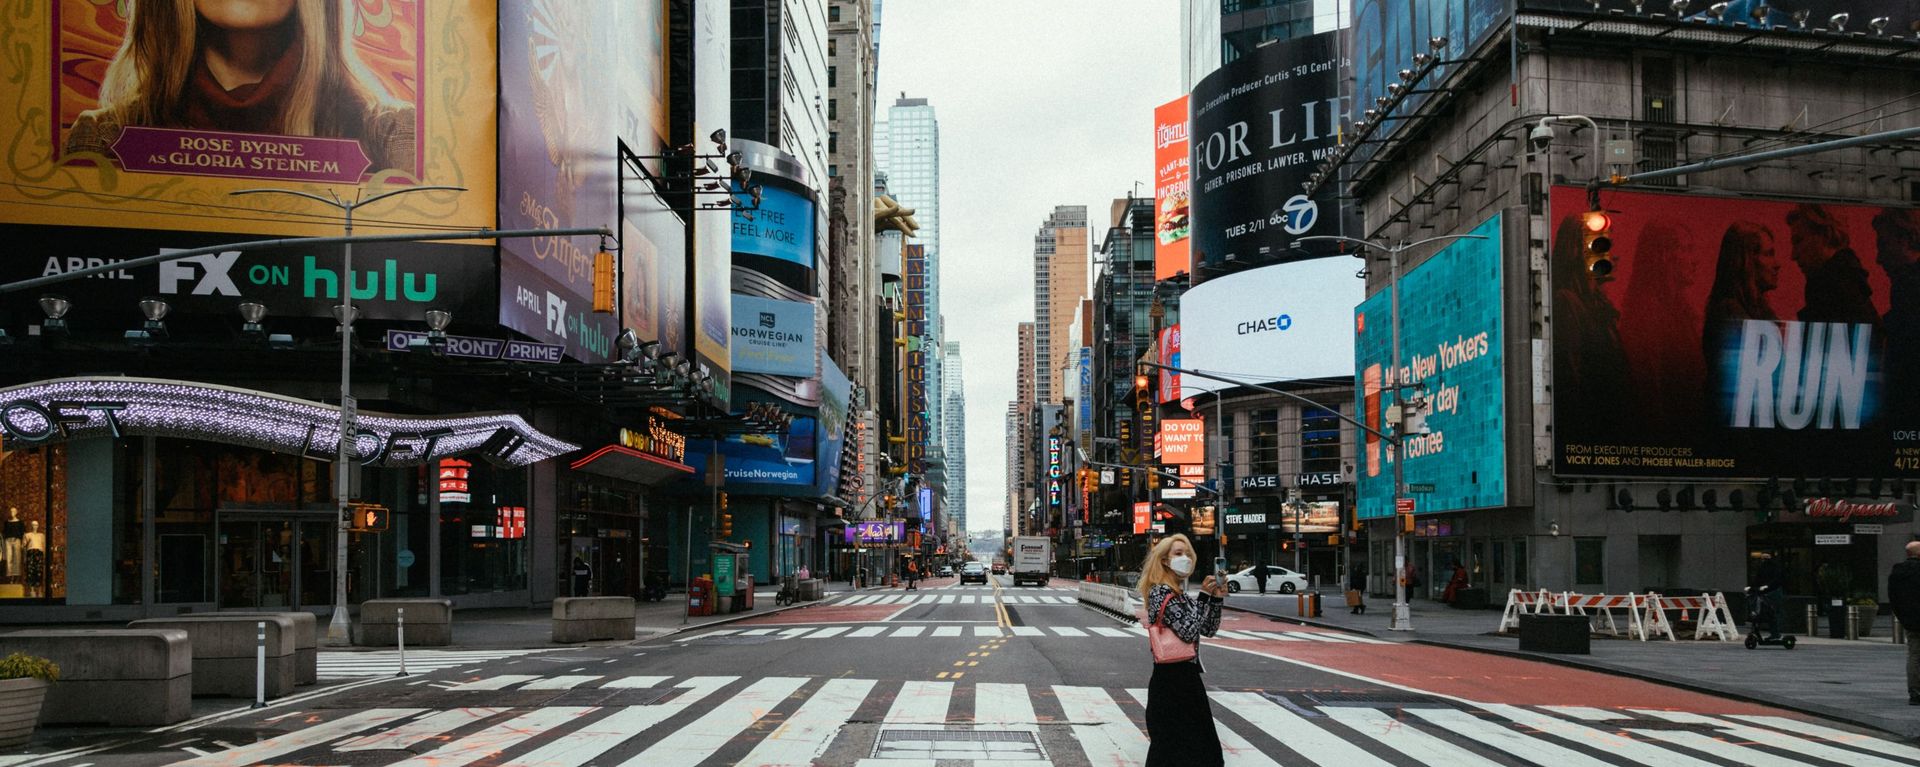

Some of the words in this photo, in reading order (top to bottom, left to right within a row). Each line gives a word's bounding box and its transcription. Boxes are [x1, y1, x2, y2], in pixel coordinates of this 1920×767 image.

[1205, 92, 1230, 111] Executive
[1231, 79, 1262, 98] Producer
[1264, 70, 1290, 85] Curtis
[179, 136, 234, 152] ROSE
[240, 140, 305, 157] BYRNE
[1195, 120, 1251, 182] FOR
[149, 154, 167, 164] AS
[169, 152, 245, 169] GLORIA
[250, 157, 341, 175] STEINEM
[1204, 175, 1225, 194] FATHER.
[1226, 162, 1265, 183] PRISONER.
[1268, 153, 1308, 170] LAWYER.
[761, 209, 785, 225] FREE
[1225, 223, 1246, 239] TUES
[1249, 218, 1265, 233] 2/11
[1269, 214, 1289, 225] abc
[1283, 197, 1317, 235] 7
[733, 222, 761, 238] FEEL
[765, 228, 797, 245] MORE
[532, 207, 594, 284] Ameri
[42, 256, 135, 280] APRIL
[159, 247, 242, 297] FX
[249, 264, 289, 285] ON
[304, 256, 437, 302] hulu
[516, 285, 542, 315] APRIL
[546, 290, 568, 339] FX
[568, 314, 578, 334] ON
[580, 312, 609, 359] hulu
[760, 314, 774, 323] NCL
[1238, 317, 1278, 335] CHAS
[731, 327, 803, 343] NORWEGIAN
[510, 343, 559, 360] PRIME
[1385, 364, 1410, 394] Mre
[1412, 352, 1437, 383] New
[1439, 331, 1488, 371] Yorkers
[1730, 319, 1873, 430] RUN
[1437, 382, 1459, 415] day
[910, 352, 922, 474] TUSSAUDS
[1164, 423, 1177, 432] DO
[1180, 423, 1200, 432] YOU
[1164, 433, 1193, 442] WANT
[1893, 430, 1917, 440] LOVE
[1164, 444, 1188, 453] WIN?
[1566, 444, 1592, 455] FROM
[1594, 445, 1639, 456] EXECUTIVE
[1641, 446, 1693, 457] PRODUCERS
[1050, 438, 1060, 505] REGAL
[1184, 466, 1204, 475] LAW
[1566, 456, 1592, 465] VICKY
[1594, 456, 1620, 466] JONES
[1621, 458, 1641, 466] AND
[1642, 458, 1673, 467] PHOEBE
[1674, 458, 1735, 468] WALLER-BRIDGE
[1226, 514, 1242, 524] STEVE
[1243, 513, 1266, 524] MADDEN
[1803, 497, 1898, 523] Walgreens
